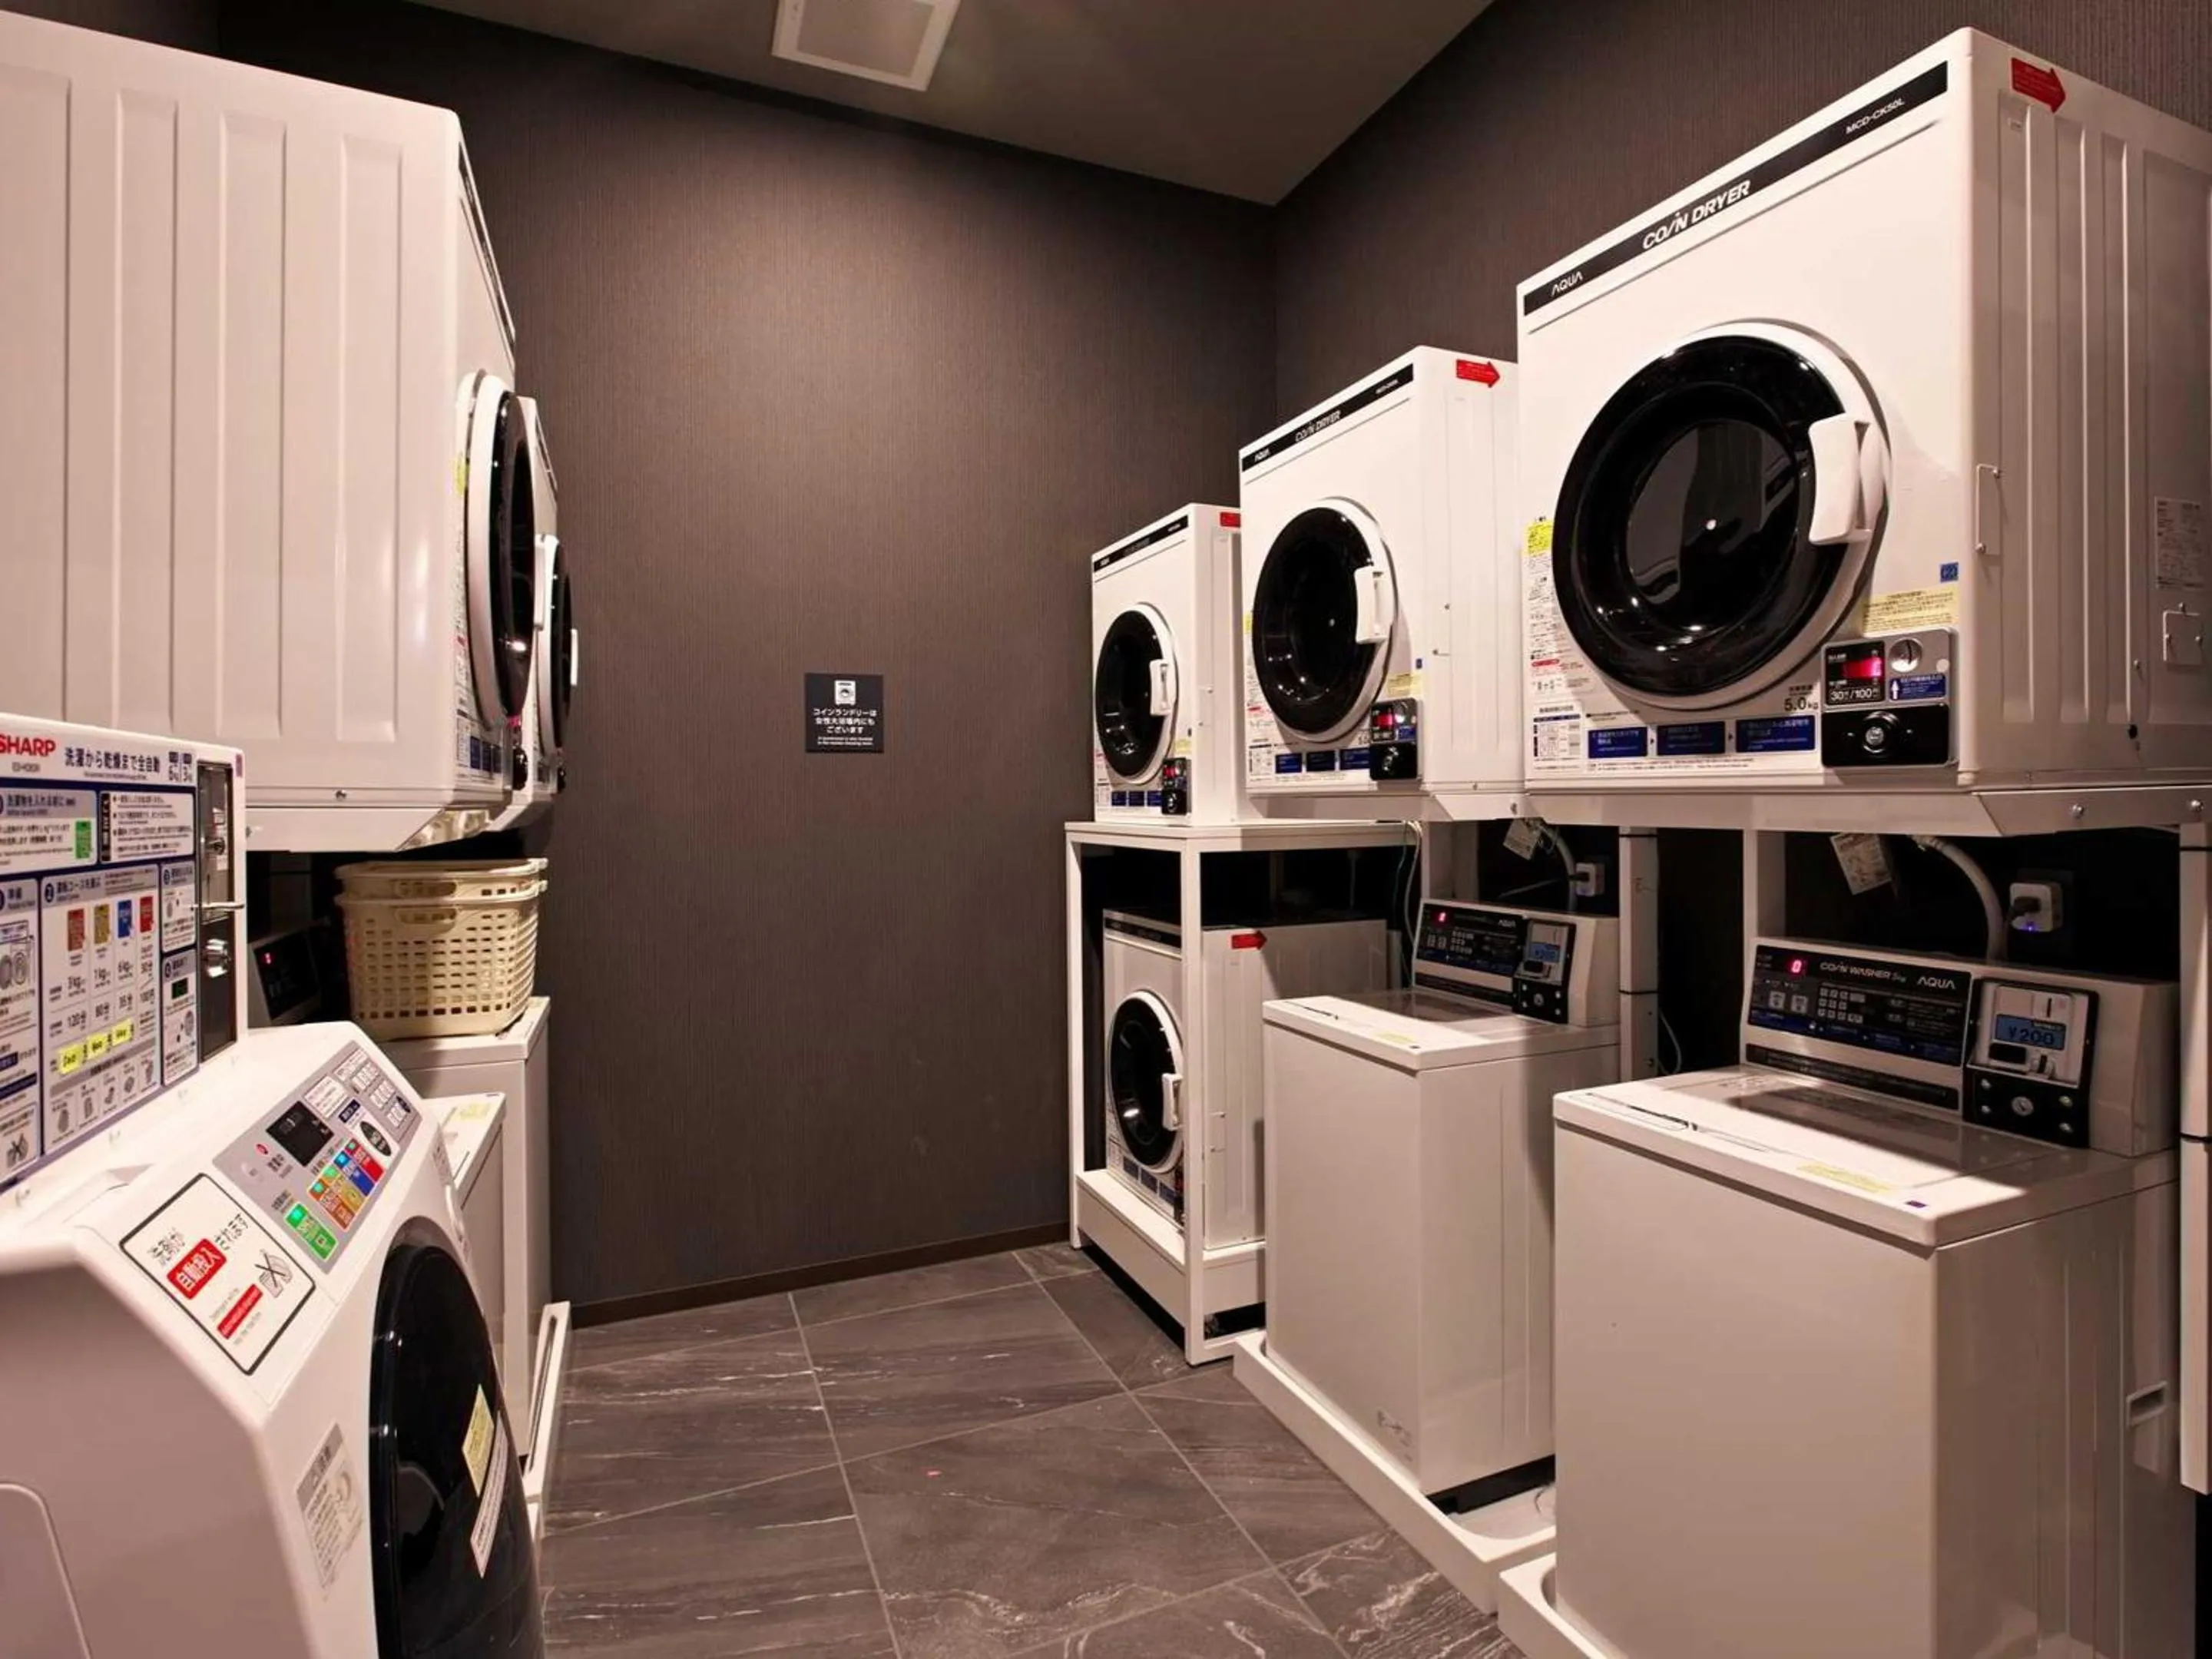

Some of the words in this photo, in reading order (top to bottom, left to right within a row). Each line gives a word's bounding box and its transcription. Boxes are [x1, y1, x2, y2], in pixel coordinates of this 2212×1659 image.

[1691, 179, 1751, 226] DRYER
[1551, 270, 1584, 297] AQUA
[813, 708, 877, 717] コインランドリーは
[0, 733, 56, 757] SHARP
[1791, 959, 1803, 974] 0
[1917, 975, 1956, 990] AQUA
